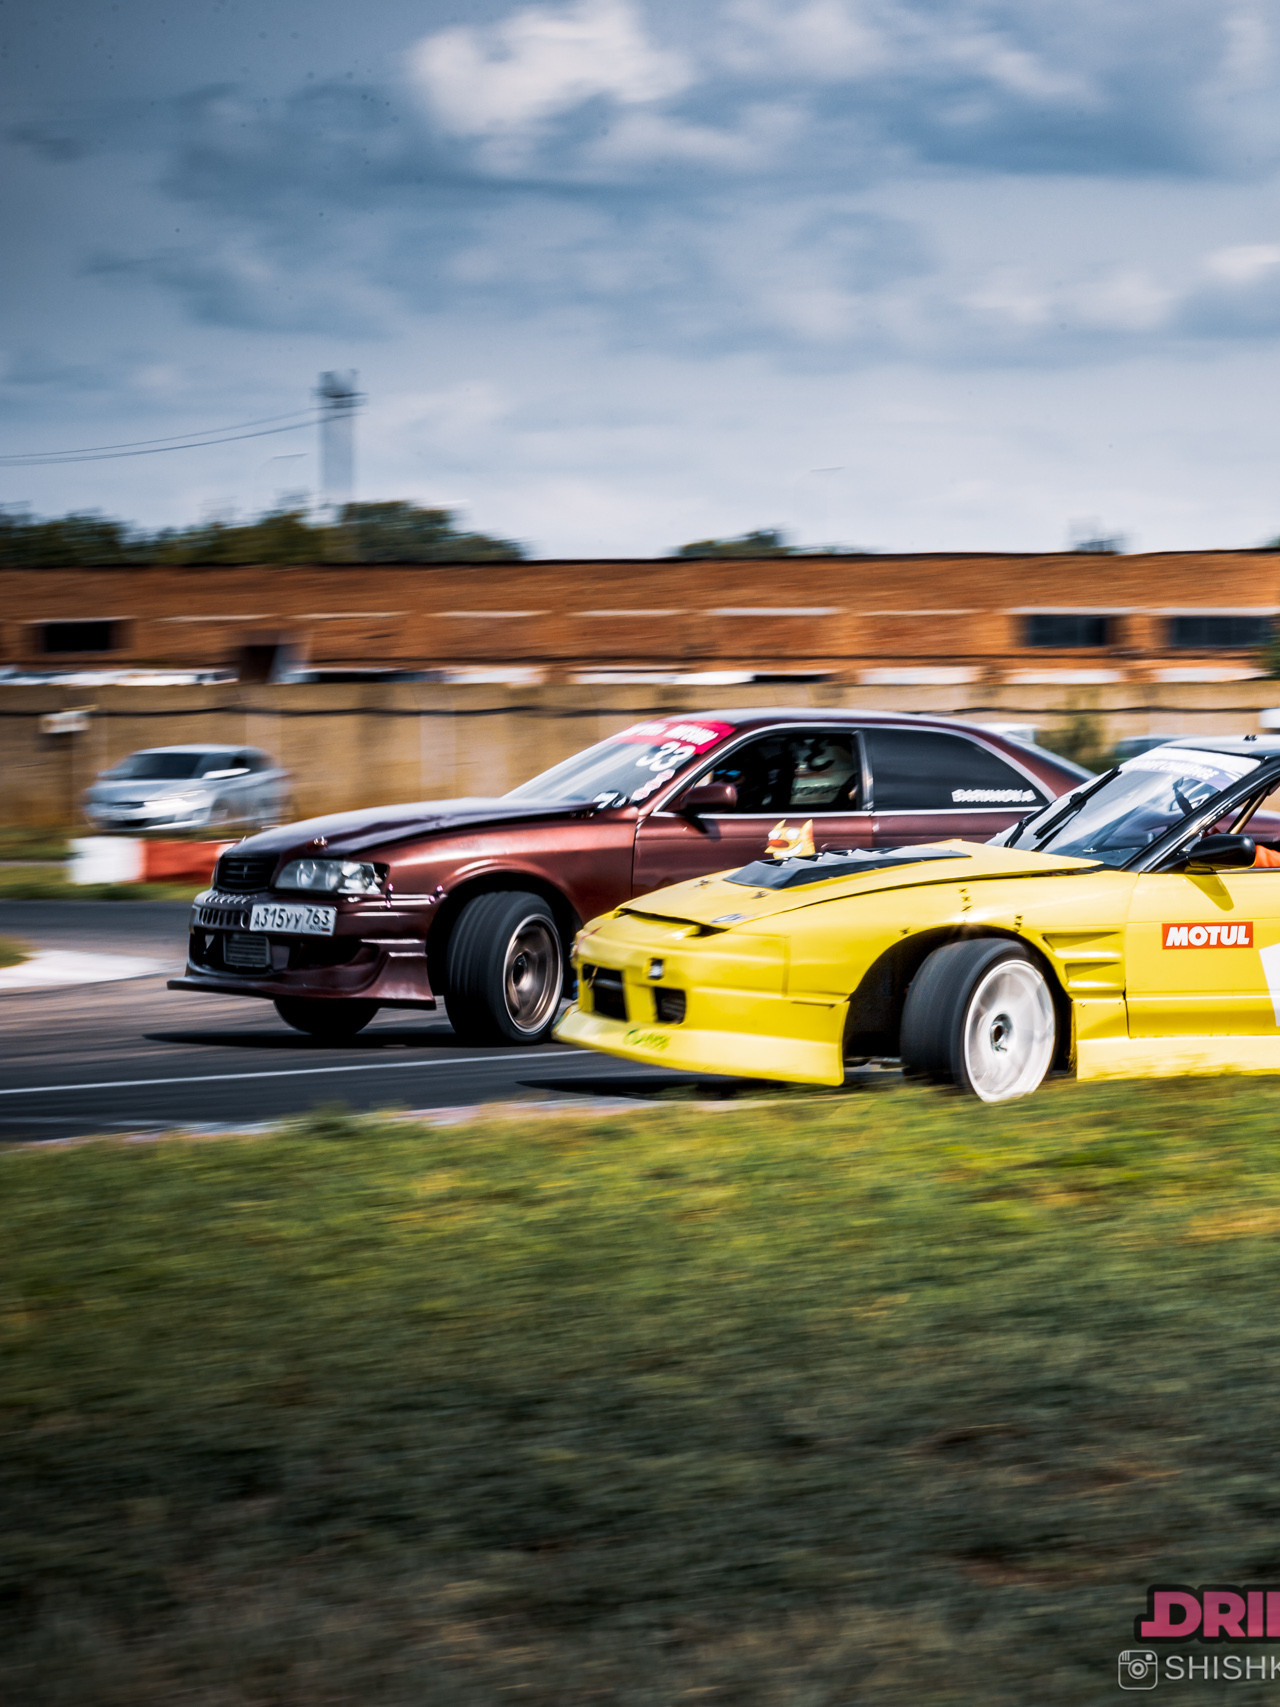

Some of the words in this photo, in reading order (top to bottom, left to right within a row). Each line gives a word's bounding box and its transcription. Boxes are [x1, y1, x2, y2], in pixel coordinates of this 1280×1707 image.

[636, 741, 696, 771] 33
[306, 908, 330, 926] 763
[1165, 925, 1250, 946] MOTUL
